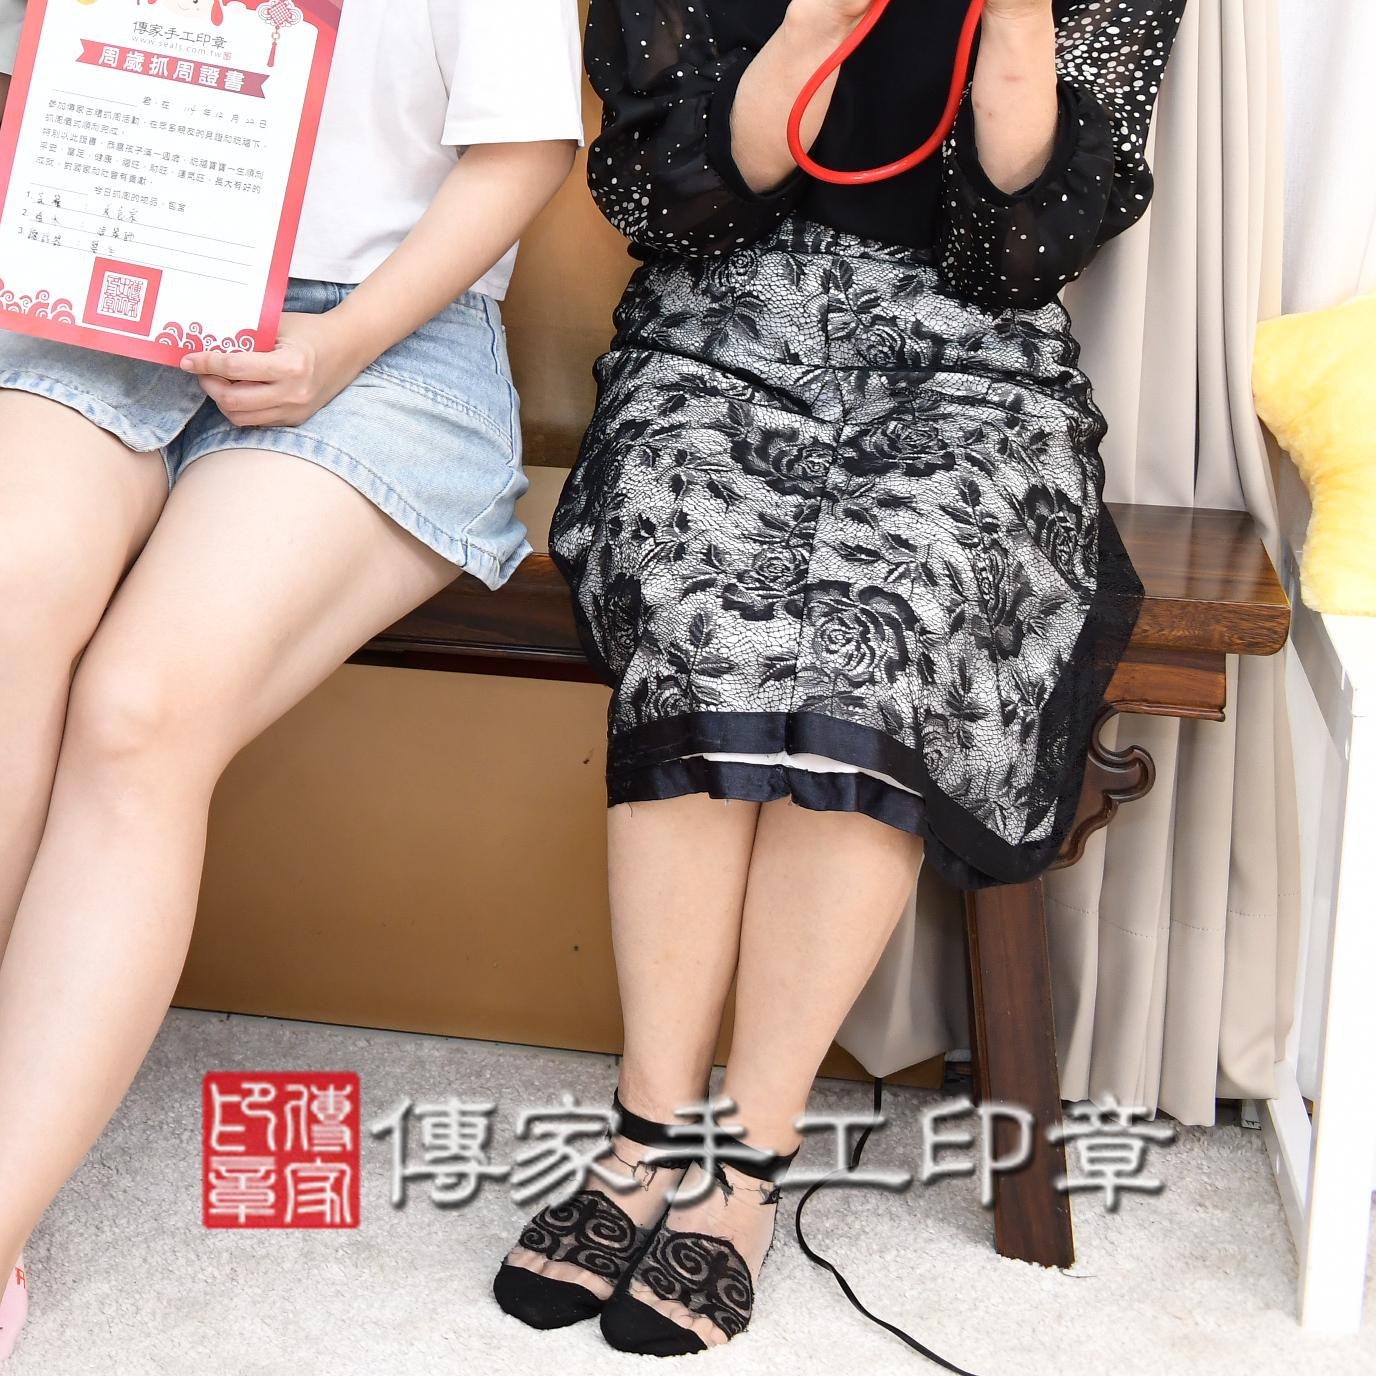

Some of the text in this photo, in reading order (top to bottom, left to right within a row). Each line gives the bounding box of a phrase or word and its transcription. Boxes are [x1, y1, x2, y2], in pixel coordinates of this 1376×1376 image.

[132, 20, 227, 50] 傳家手工印章
[98, 44, 245, 93] 周歲抓周證書
